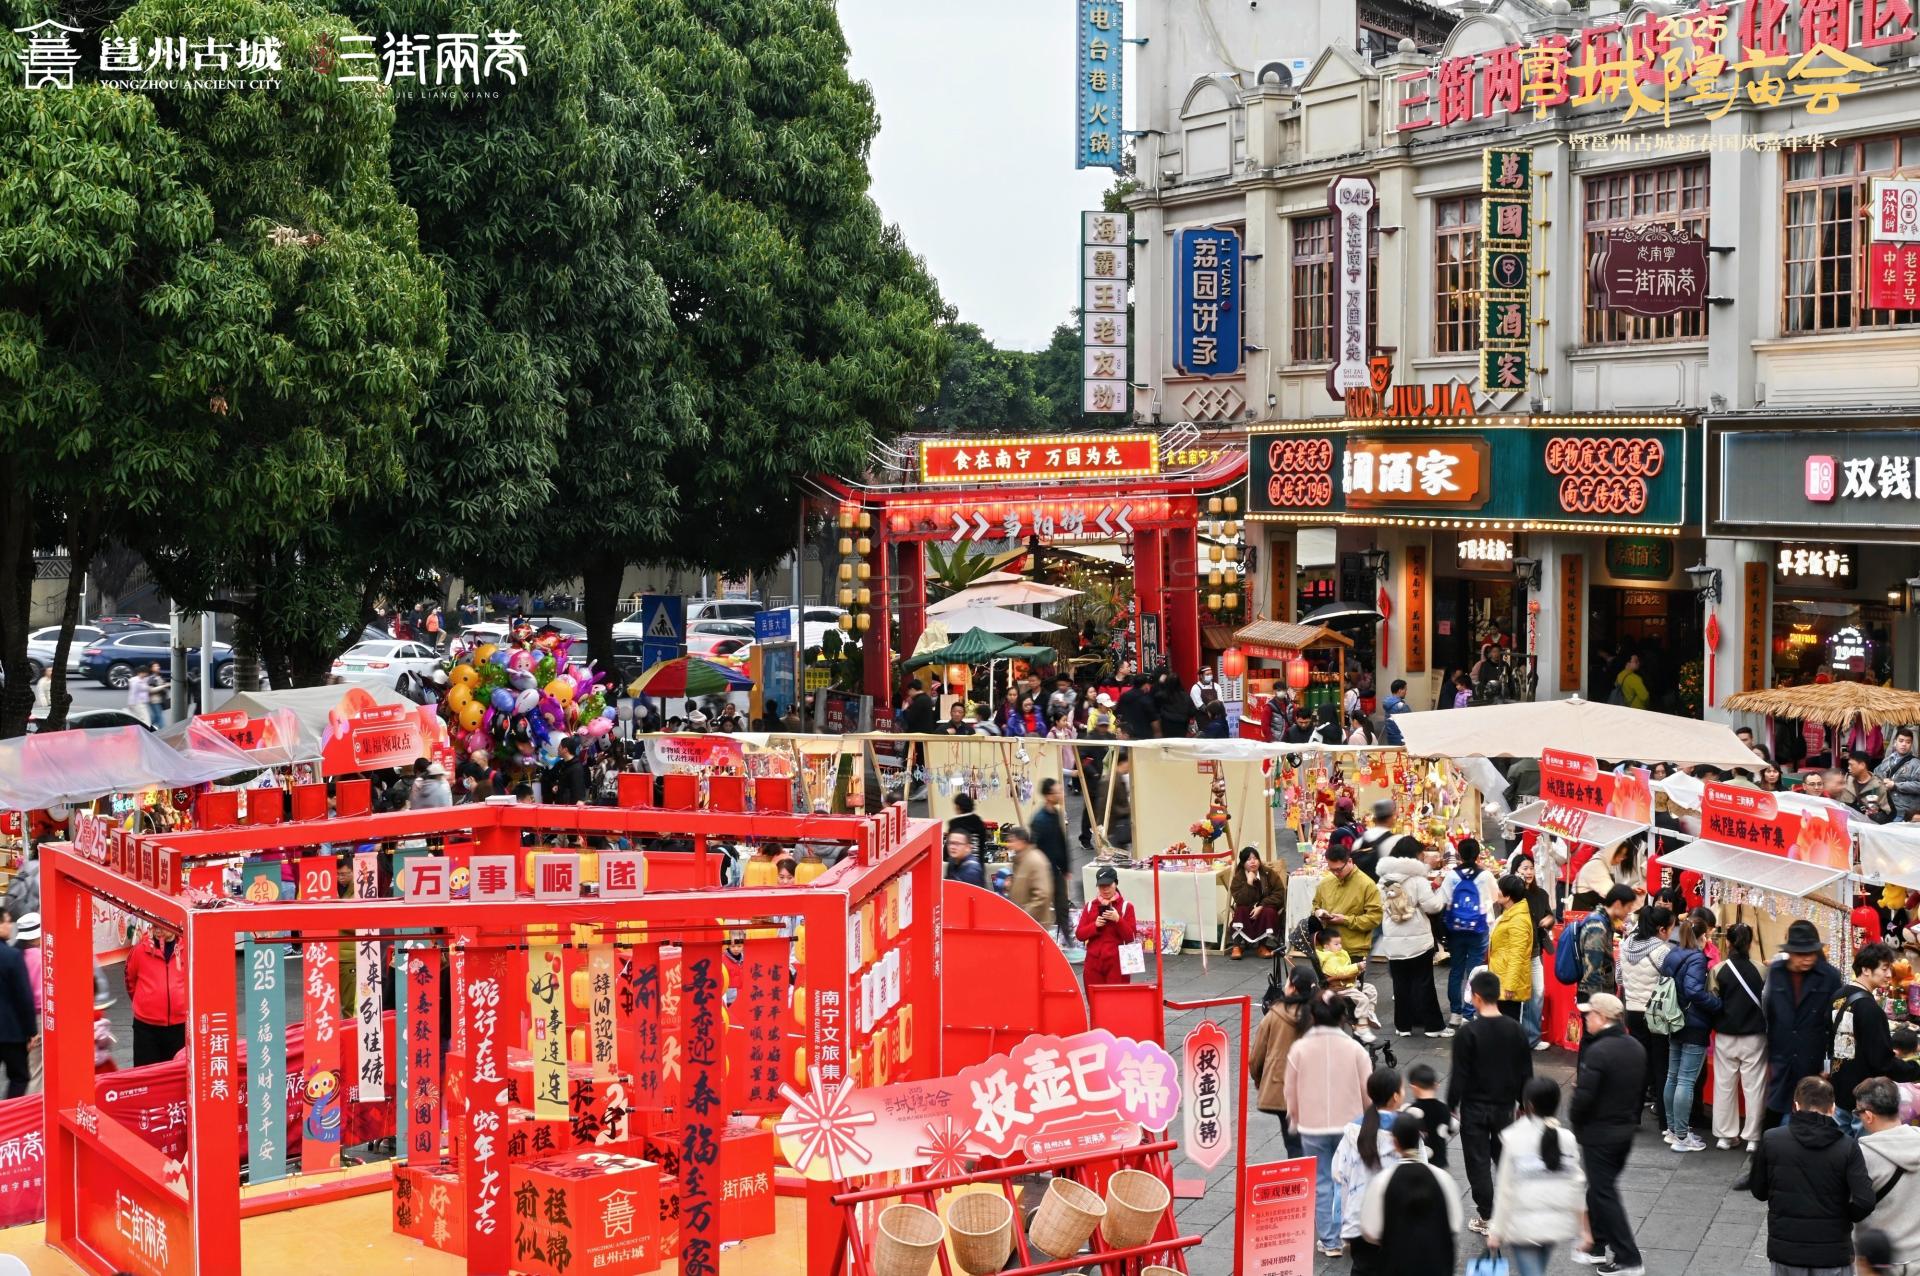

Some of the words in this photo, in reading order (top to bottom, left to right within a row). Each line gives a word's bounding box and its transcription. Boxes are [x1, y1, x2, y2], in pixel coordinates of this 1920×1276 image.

[1088, 7, 1110, 155] 电台巷火锅
[1340, 188, 1370, 205] 1945
[1221, 238, 1232, 252] LI
[1346, 212, 1361, 283] 食在南宁
[1221, 259, 1232, 296] YUAN
[1883, 251, 1896, 285] 中华
[1903, 252, 1917, 305] 老字号
[1093, 216, 1116, 409] 海霸王老友粉
[1387, 383, 1475, 418] JIUJIA
[952, 449, 1032, 471] 食在南宁
[1045, 445, 1123, 467] 万国为先
[1270, 441, 1332, 470] 广西老字号
[1548, 441, 1663, 474] 非物质文化遗产
[1841, 455, 1920, 500] 双钱
[1564, 480, 1644, 511] 南宁传承菜
[1002, 508, 1087, 538] 当阳街
[362, 732, 411, 754] 集福领取点
[1546, 777, 1604, 807] 城隍庙会市集
[1710, 814, 1785, 849] 城隍庙会市集
[306, 870, 331, 893] 20
[411, 860, 637, 896] 万事顺遂
[254, 949, 276, 970] 20
[254, 970, 276, 990] 25
[306, 943, 335, 1042] 蛇年大吉
[468, 978, 504, 1083] 蛇行大运
[256, 997, 276, 1161] 多福多财多平安
[473, 1109, 501, 1235] 蛇年大吉
[720, 1172, 769, 1201] 街兩巷
[587, 1243, 615, 1254] YONGZHOU
[638, 1235, 651, 1243] CITY
[593, 1245, 645, 1268] 邕州古城
